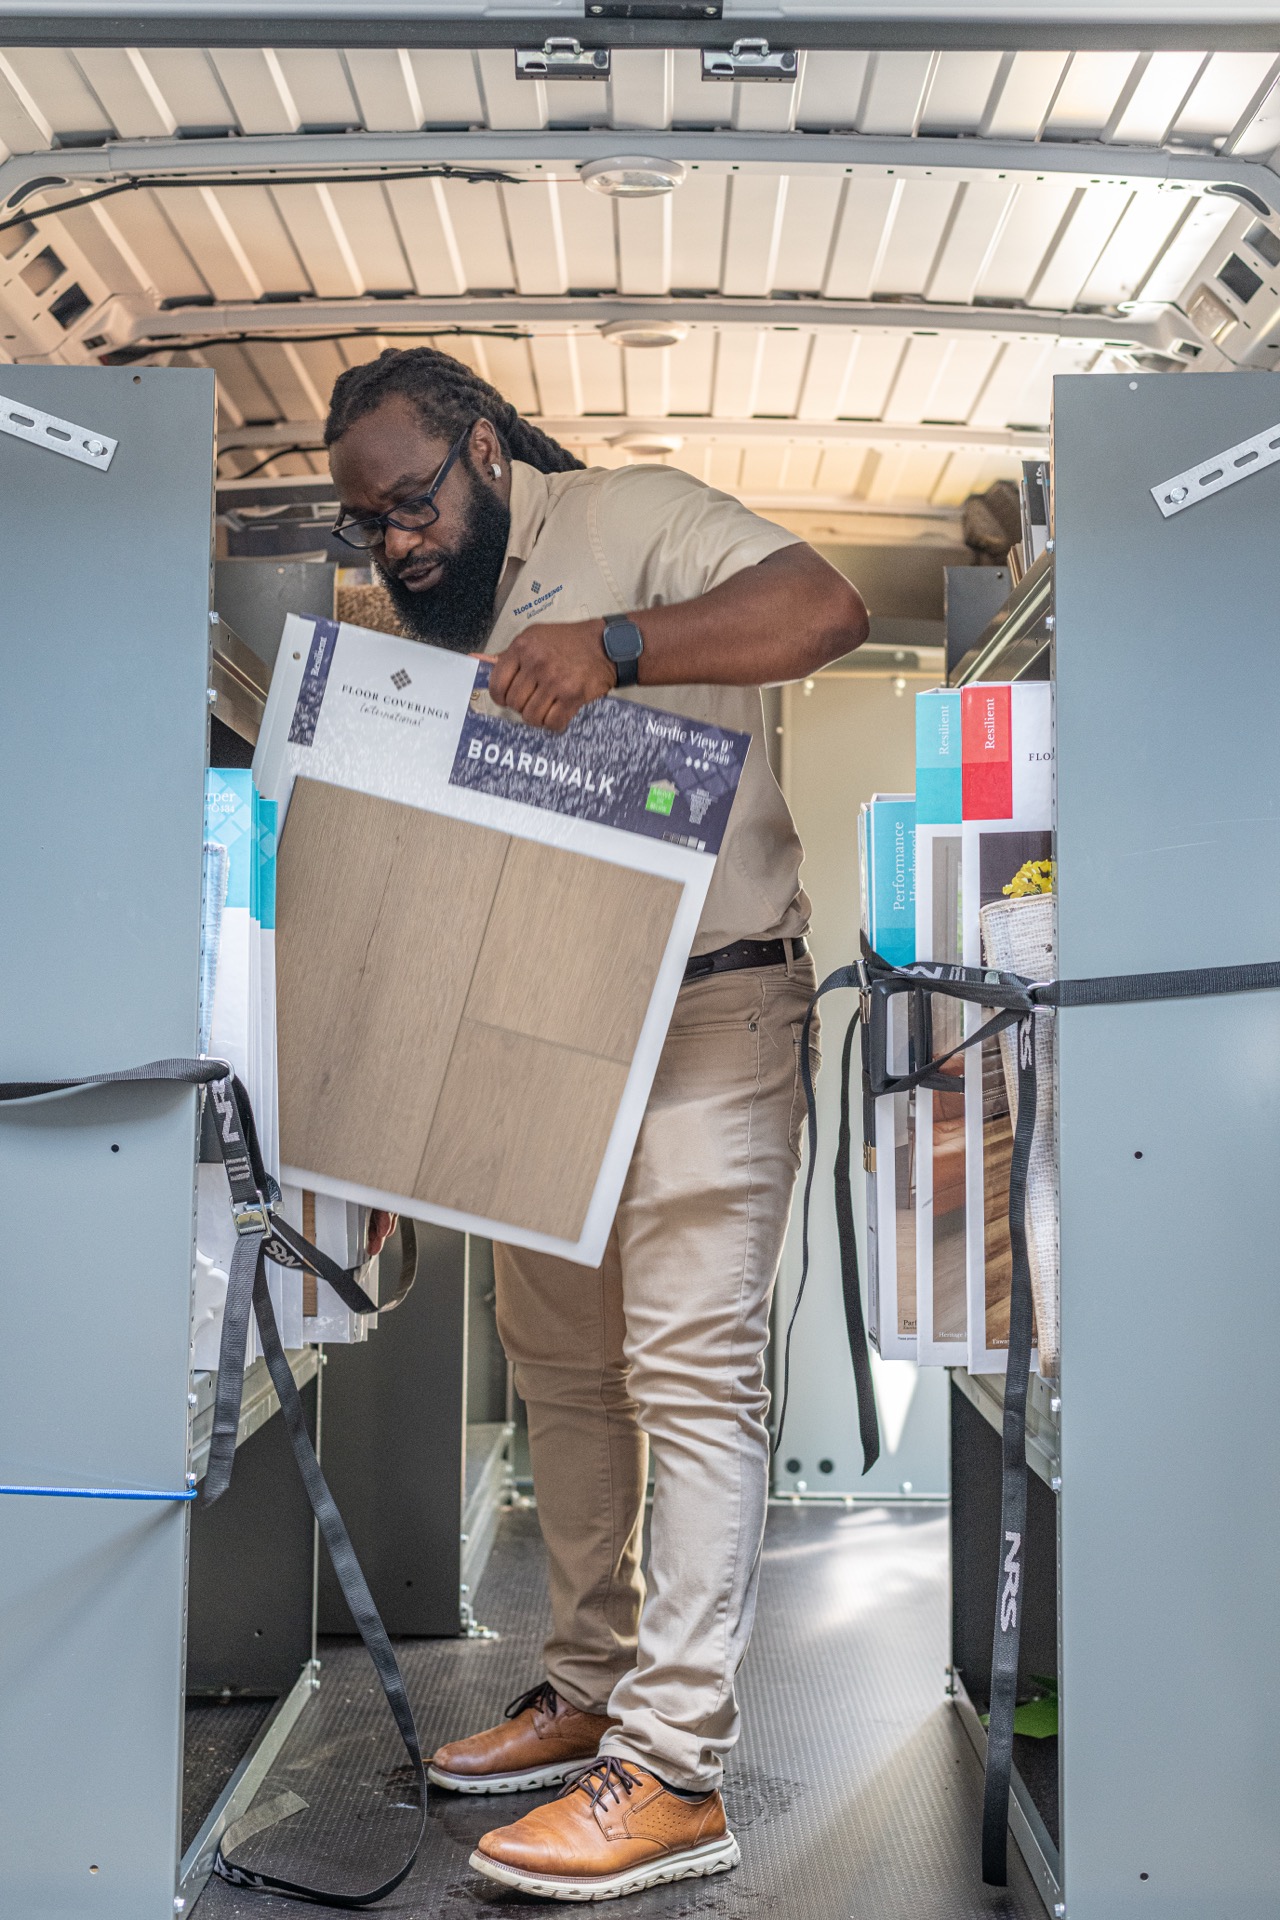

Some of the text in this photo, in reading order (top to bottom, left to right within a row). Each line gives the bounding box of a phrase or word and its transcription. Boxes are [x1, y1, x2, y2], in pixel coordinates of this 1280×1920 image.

[513, 584, 563, 616] FLOOR COVERINGS
[341, 684, 450, 720] FLOOR COVERINGS
[359, 702, 424, 728] International
[645, 718, 687, 744] Nordic
[689, 730, 719, 751] View
[939, 705, 950, 756] Resilient
[984, 698, 996, 750] Resilient
[467, 738, 615, 796] BOARDWALK
[207, 792, 236, 806] rper
[892, 821, 905, 912] Performance
[211, 1080, 241, 1143] NR
[264, 1240, 303, 1267] NRS
[1000, 1530, 1021, 1633] NRS
